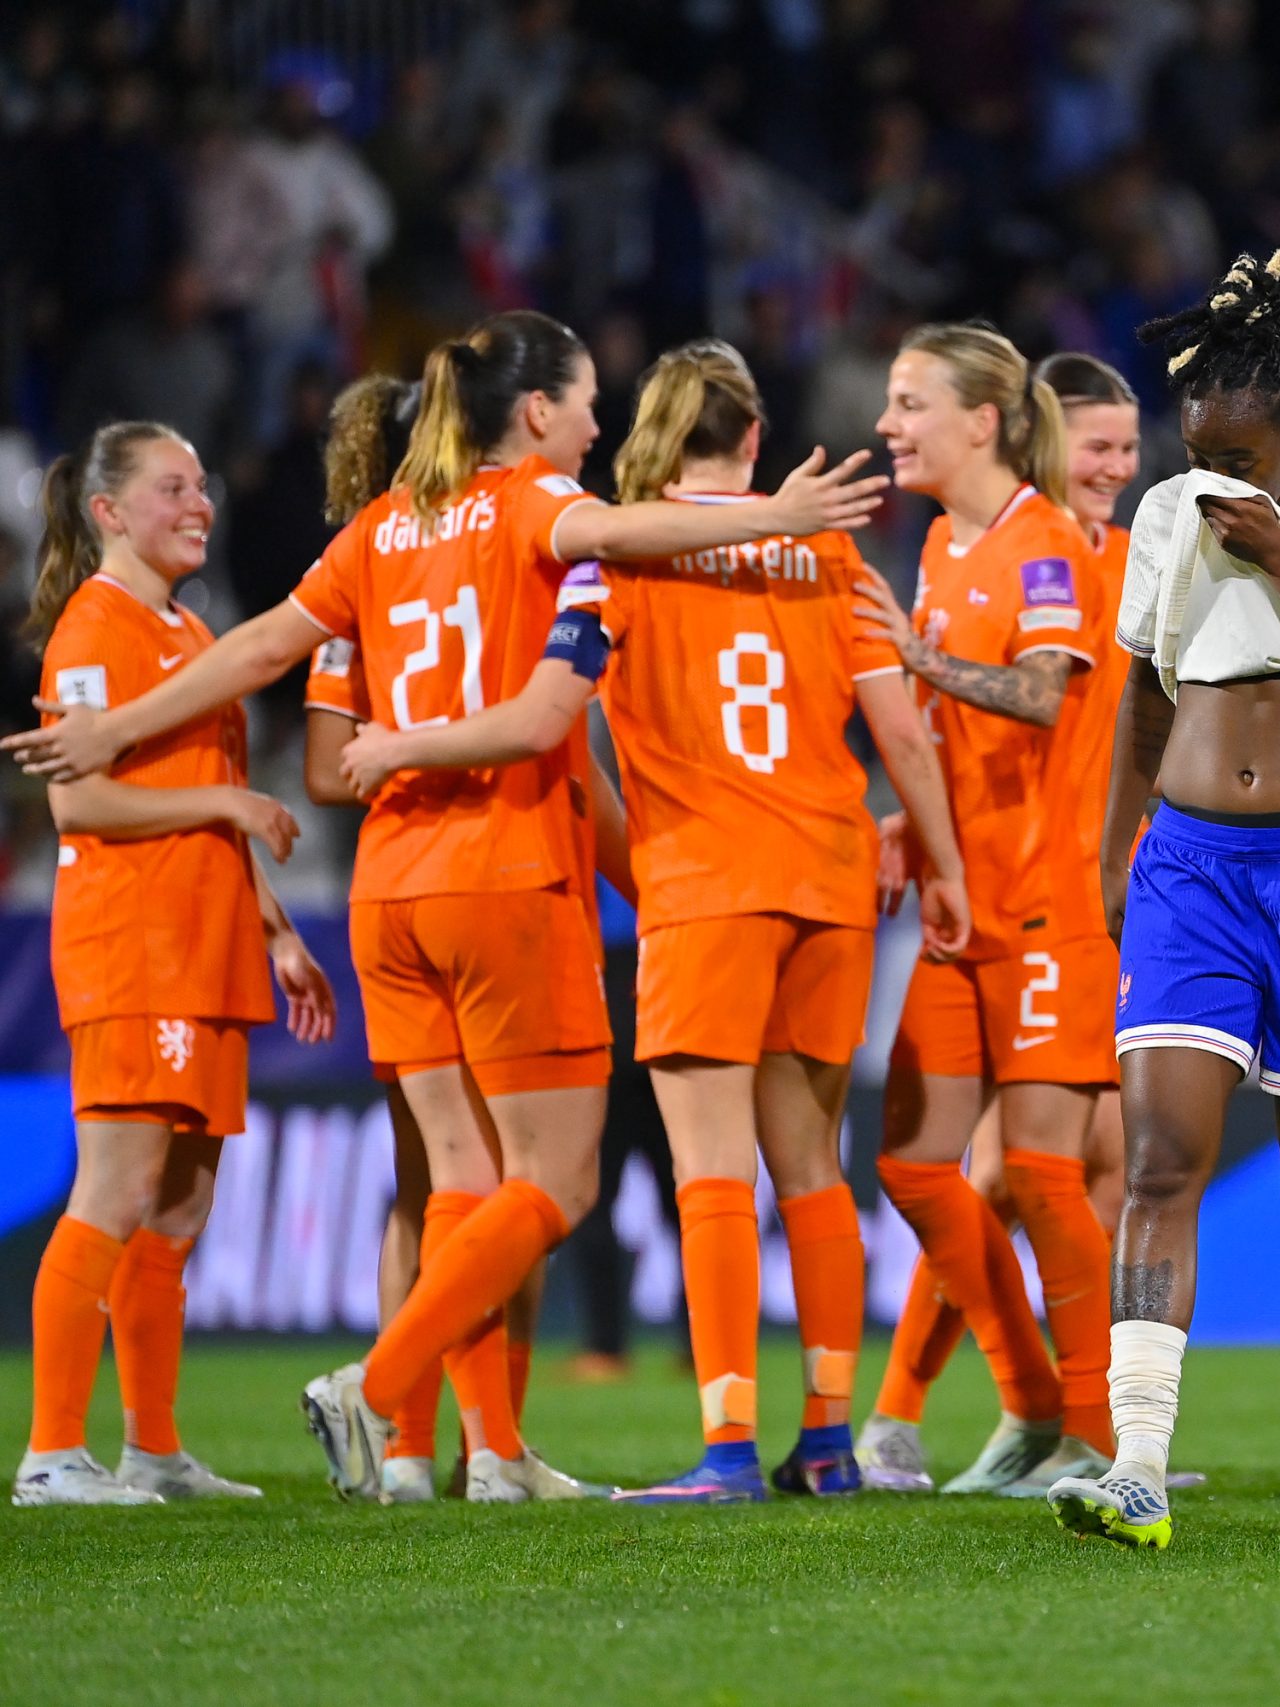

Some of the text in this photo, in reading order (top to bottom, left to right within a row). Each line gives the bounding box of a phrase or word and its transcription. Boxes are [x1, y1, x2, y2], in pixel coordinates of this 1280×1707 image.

[388, 584, 485, 732] 21
[717, 632, 789, 775] 8
[1020, 951, 1060, 1027] 2
